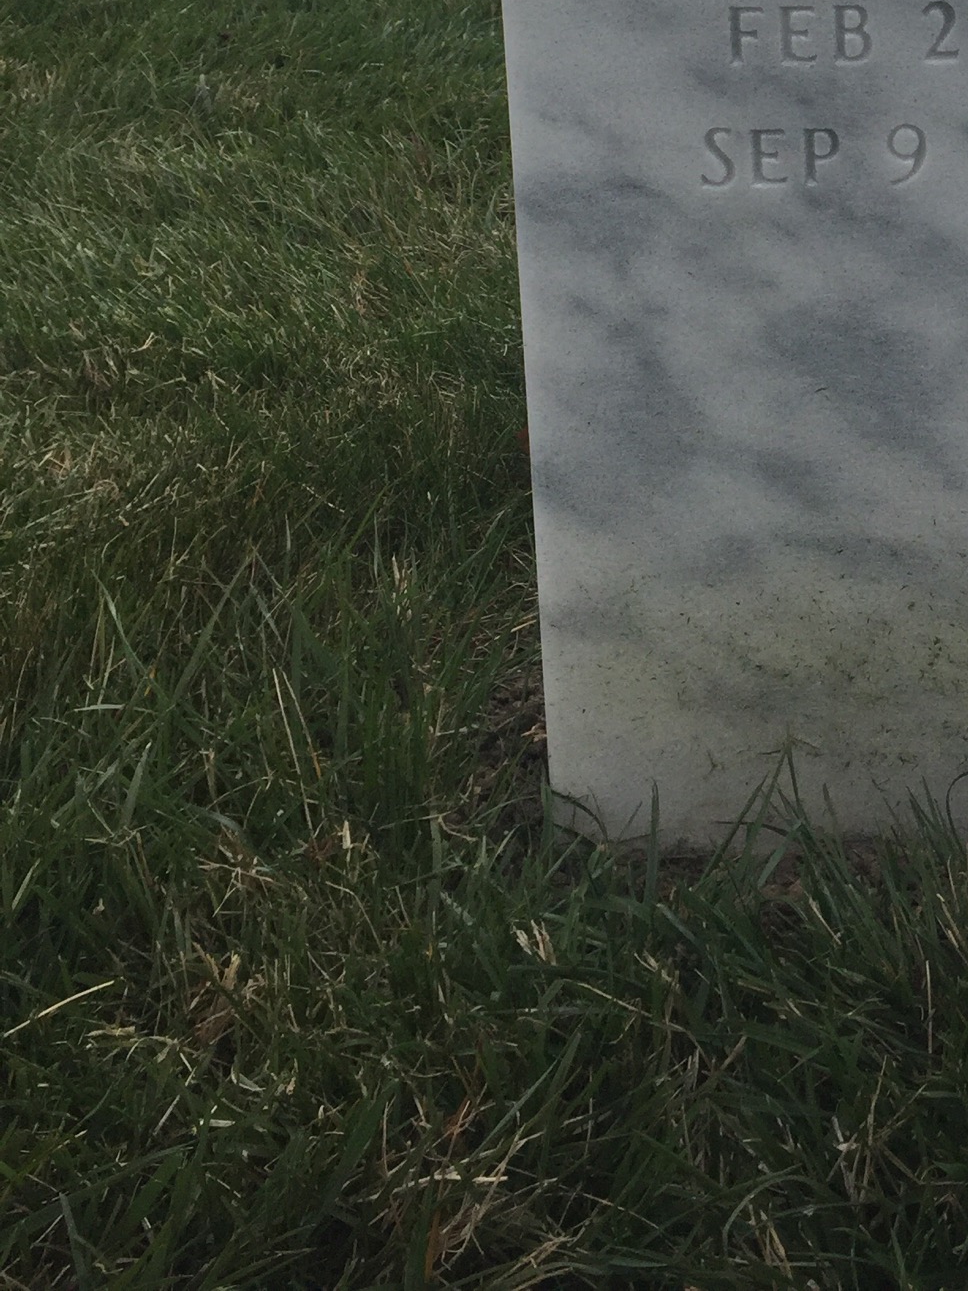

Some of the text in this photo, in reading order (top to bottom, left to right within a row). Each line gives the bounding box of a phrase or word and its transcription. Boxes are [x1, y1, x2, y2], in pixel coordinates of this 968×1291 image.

[728, 4, 873, 65] FEB
[920, 0, 960, 62] 2
[701, 126, 840, 187] SEP
[886, 123, 928, 185] 9
